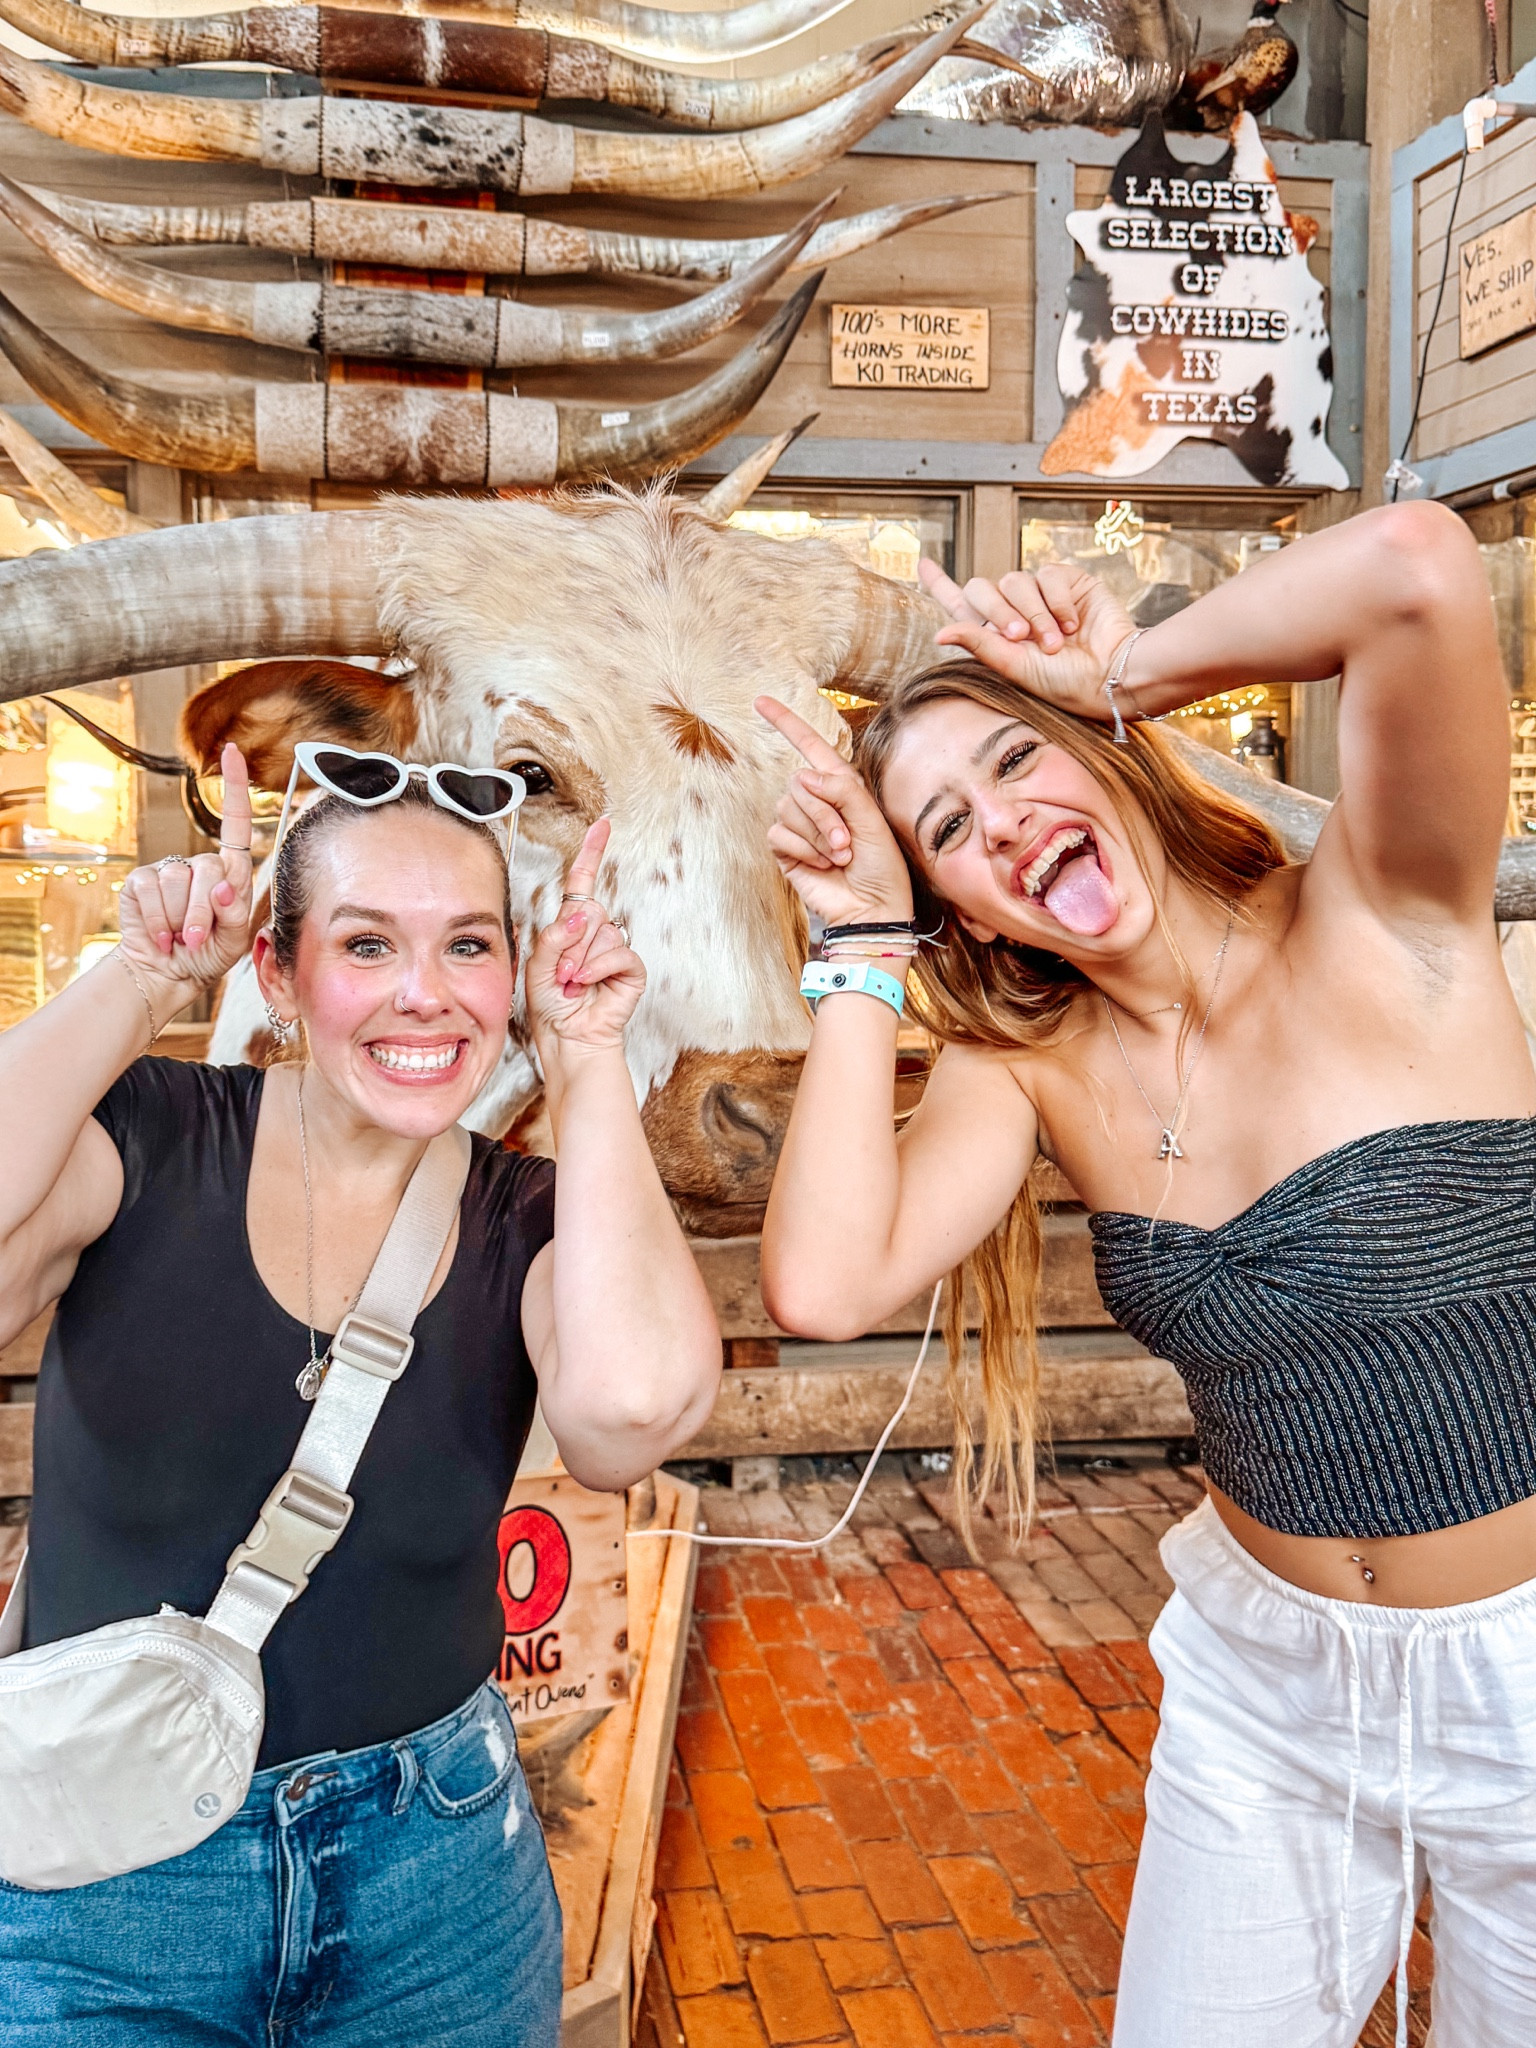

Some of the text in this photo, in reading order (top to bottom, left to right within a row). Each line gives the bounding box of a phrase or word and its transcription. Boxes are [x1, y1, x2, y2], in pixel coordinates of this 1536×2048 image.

[1125, 176, 1276, 212] LARGEST
[1107, 219, 1294, 256] SELECTION
[1181, 264, 1223, 293] OF
[1466, 259, 1534, 306] WE SHIP
[901, 313, 961, 336] MORE
[1110, 306, 1290, 340] COWHIDES
[843, 341, 976, 361] HORNS INSIDE
[1182, 350, 1220, 379] IN
[857, 363, 973, 386] KO TRADING
[1142, 393, 1258, 425] TEXAS
[496, 1504, 572, 1637] O
[495, 1631, 562, 1682] ING
